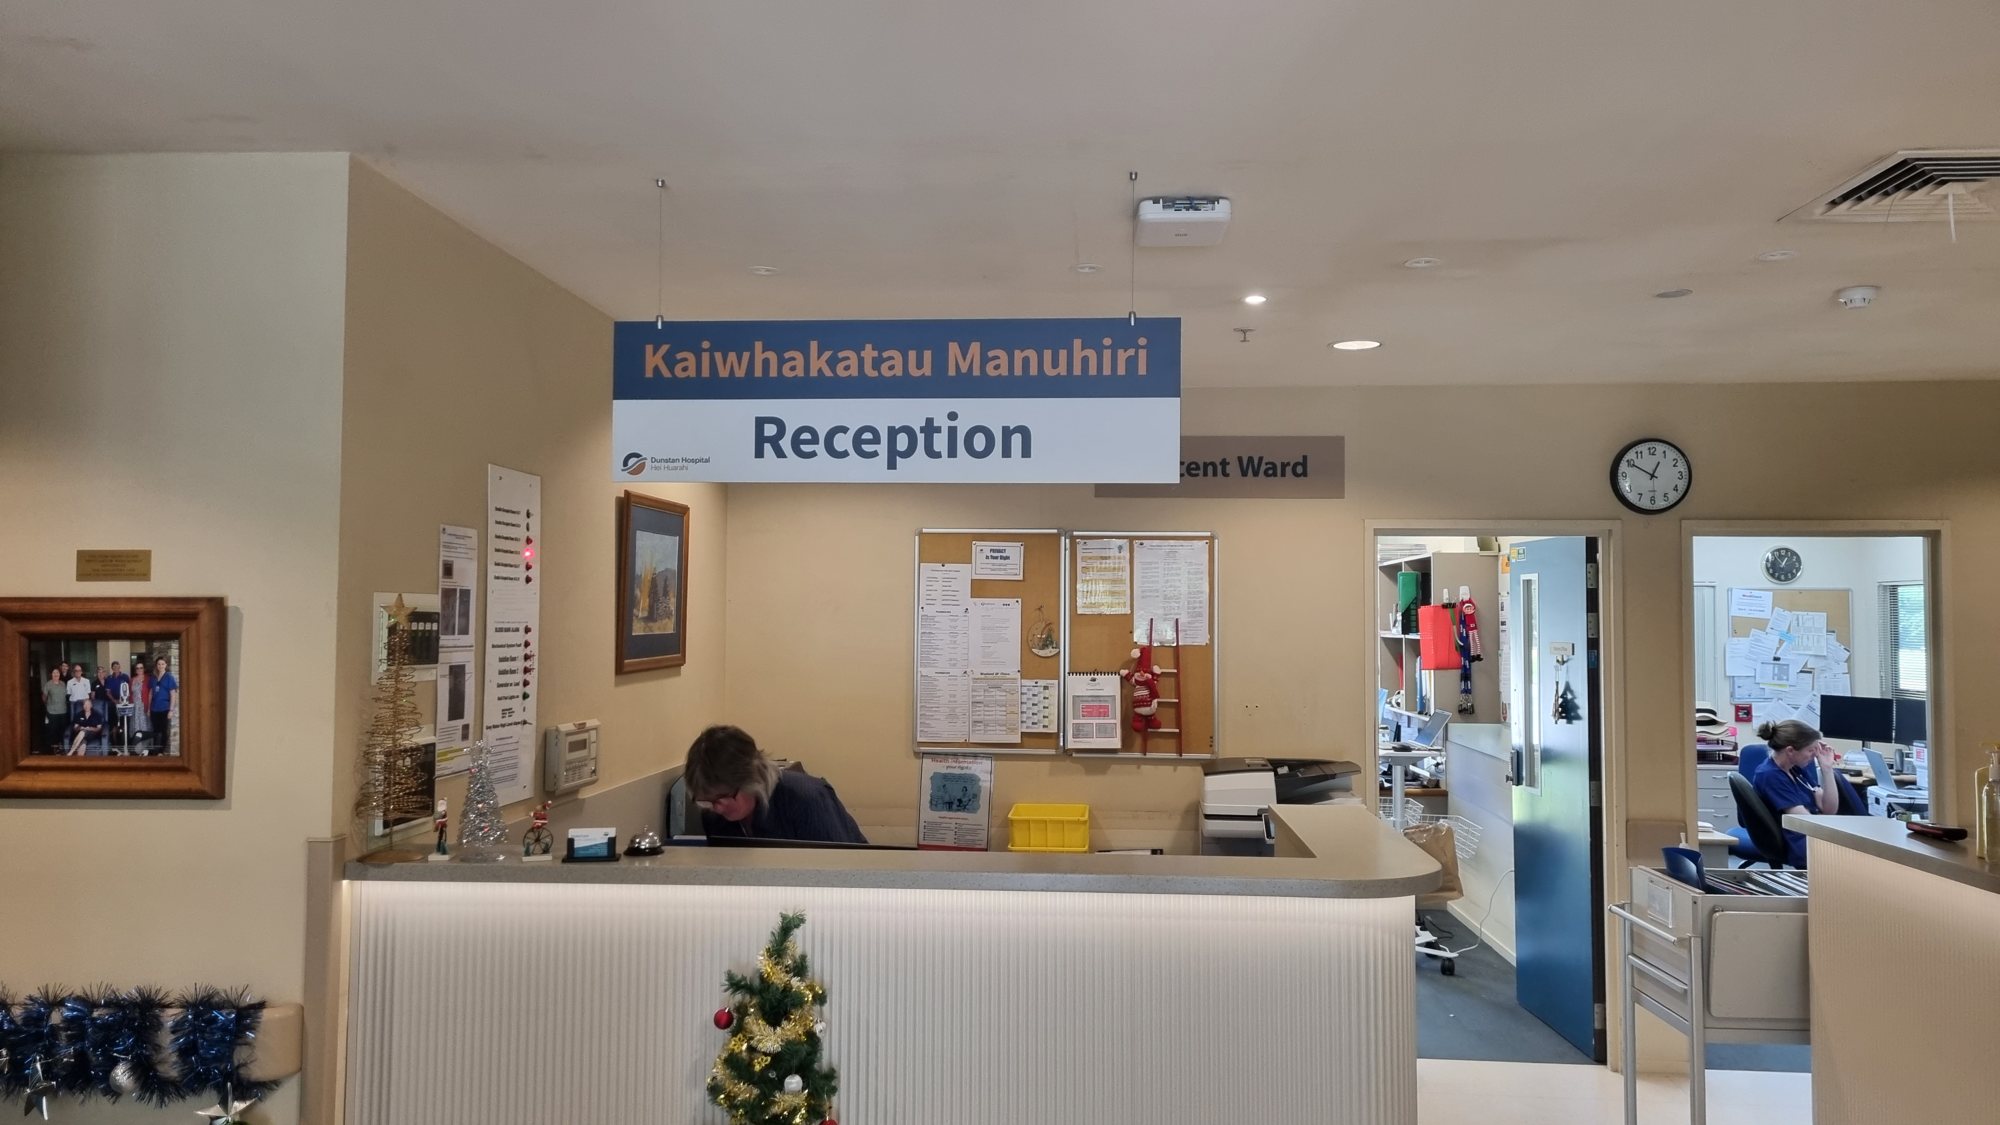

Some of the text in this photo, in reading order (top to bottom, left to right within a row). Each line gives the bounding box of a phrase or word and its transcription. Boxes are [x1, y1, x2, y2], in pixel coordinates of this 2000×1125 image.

[644, 337, 1148, 378] Kaiwhakatau Manuhiri
[754, 411, 1032, 470] Reception
[681, 456, 710, 464] Hospital
[1237, 455, 1308, 478] Ward
